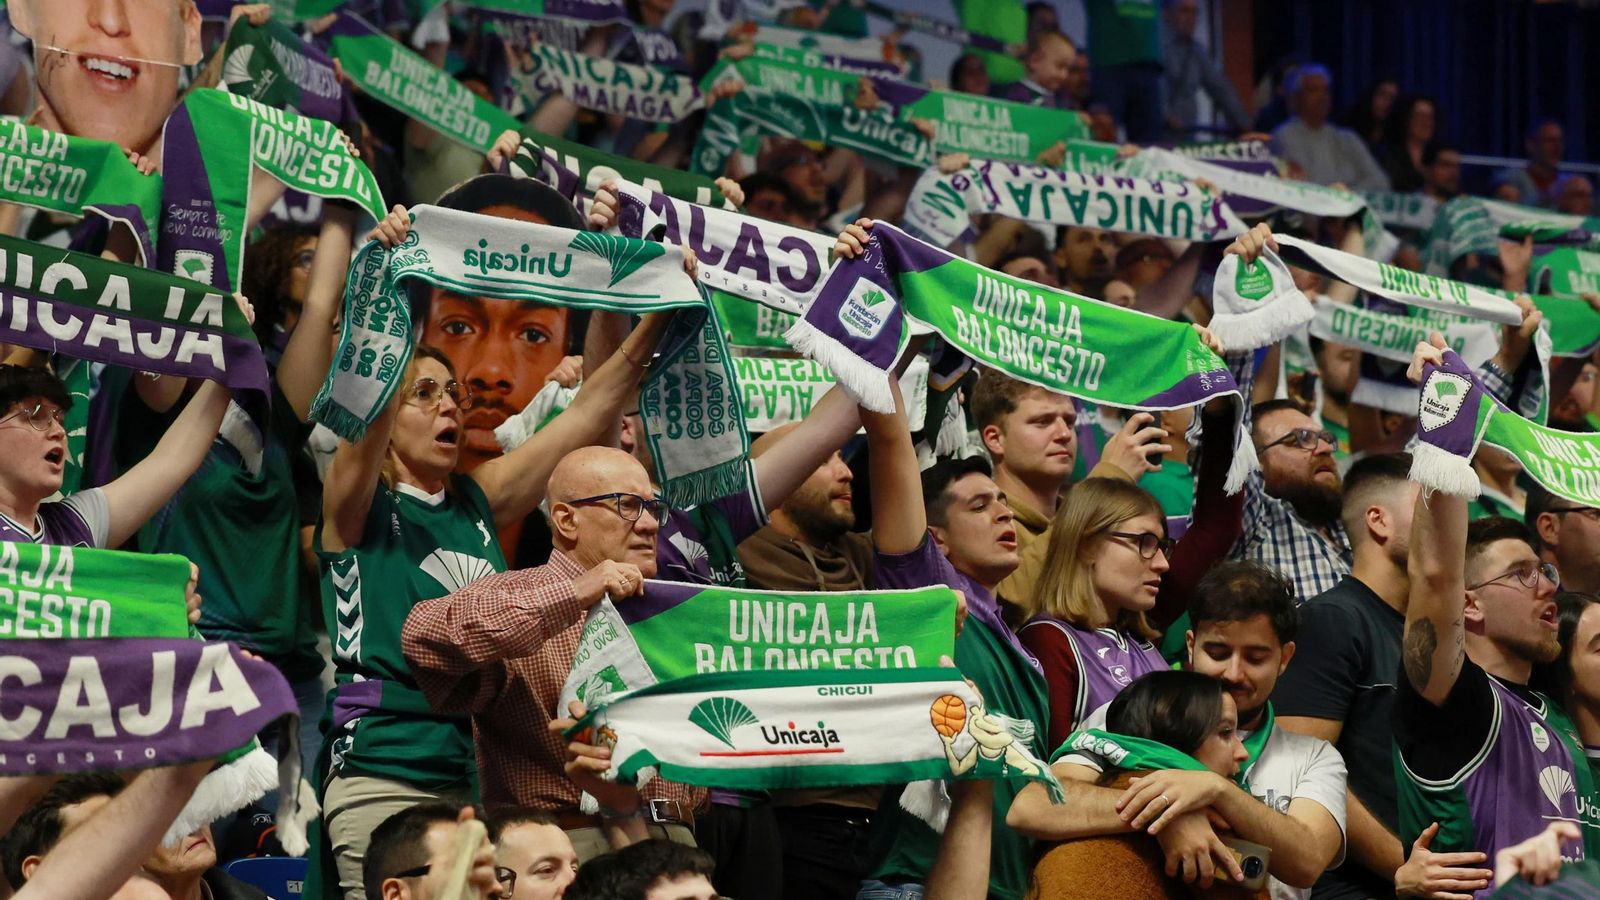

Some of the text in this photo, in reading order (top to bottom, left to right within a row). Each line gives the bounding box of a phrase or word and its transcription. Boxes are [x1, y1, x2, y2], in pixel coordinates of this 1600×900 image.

[365, 61, 490, 145] BALONCESTO
[390, 47, 475, 115] UNICAJA
[0, 152, 88, 204] CESTO
[168, 203, 226, 225] Siempre te
[1005, 181, 1194, 240] UNICAJA
[0, 247, 226, 372] ICAJA
[848, 298, 881, 326] Fundación
[849, 309, 873, 330] Unicaja
[973, 273, 1083, 344] UNICAJA
[952, 304, 1106, 392] BALONCESTO
[1426, 397, 1450, 411] Unicaja
[729, 599, 879, 645] UNICAJA
[694, 642, 918, 673] BALONCESTO
[0, 642, 261, 742] CAJA
[817, 685, 874, 697] CHICUI
[761, 720, 840, 748] Unicaja
